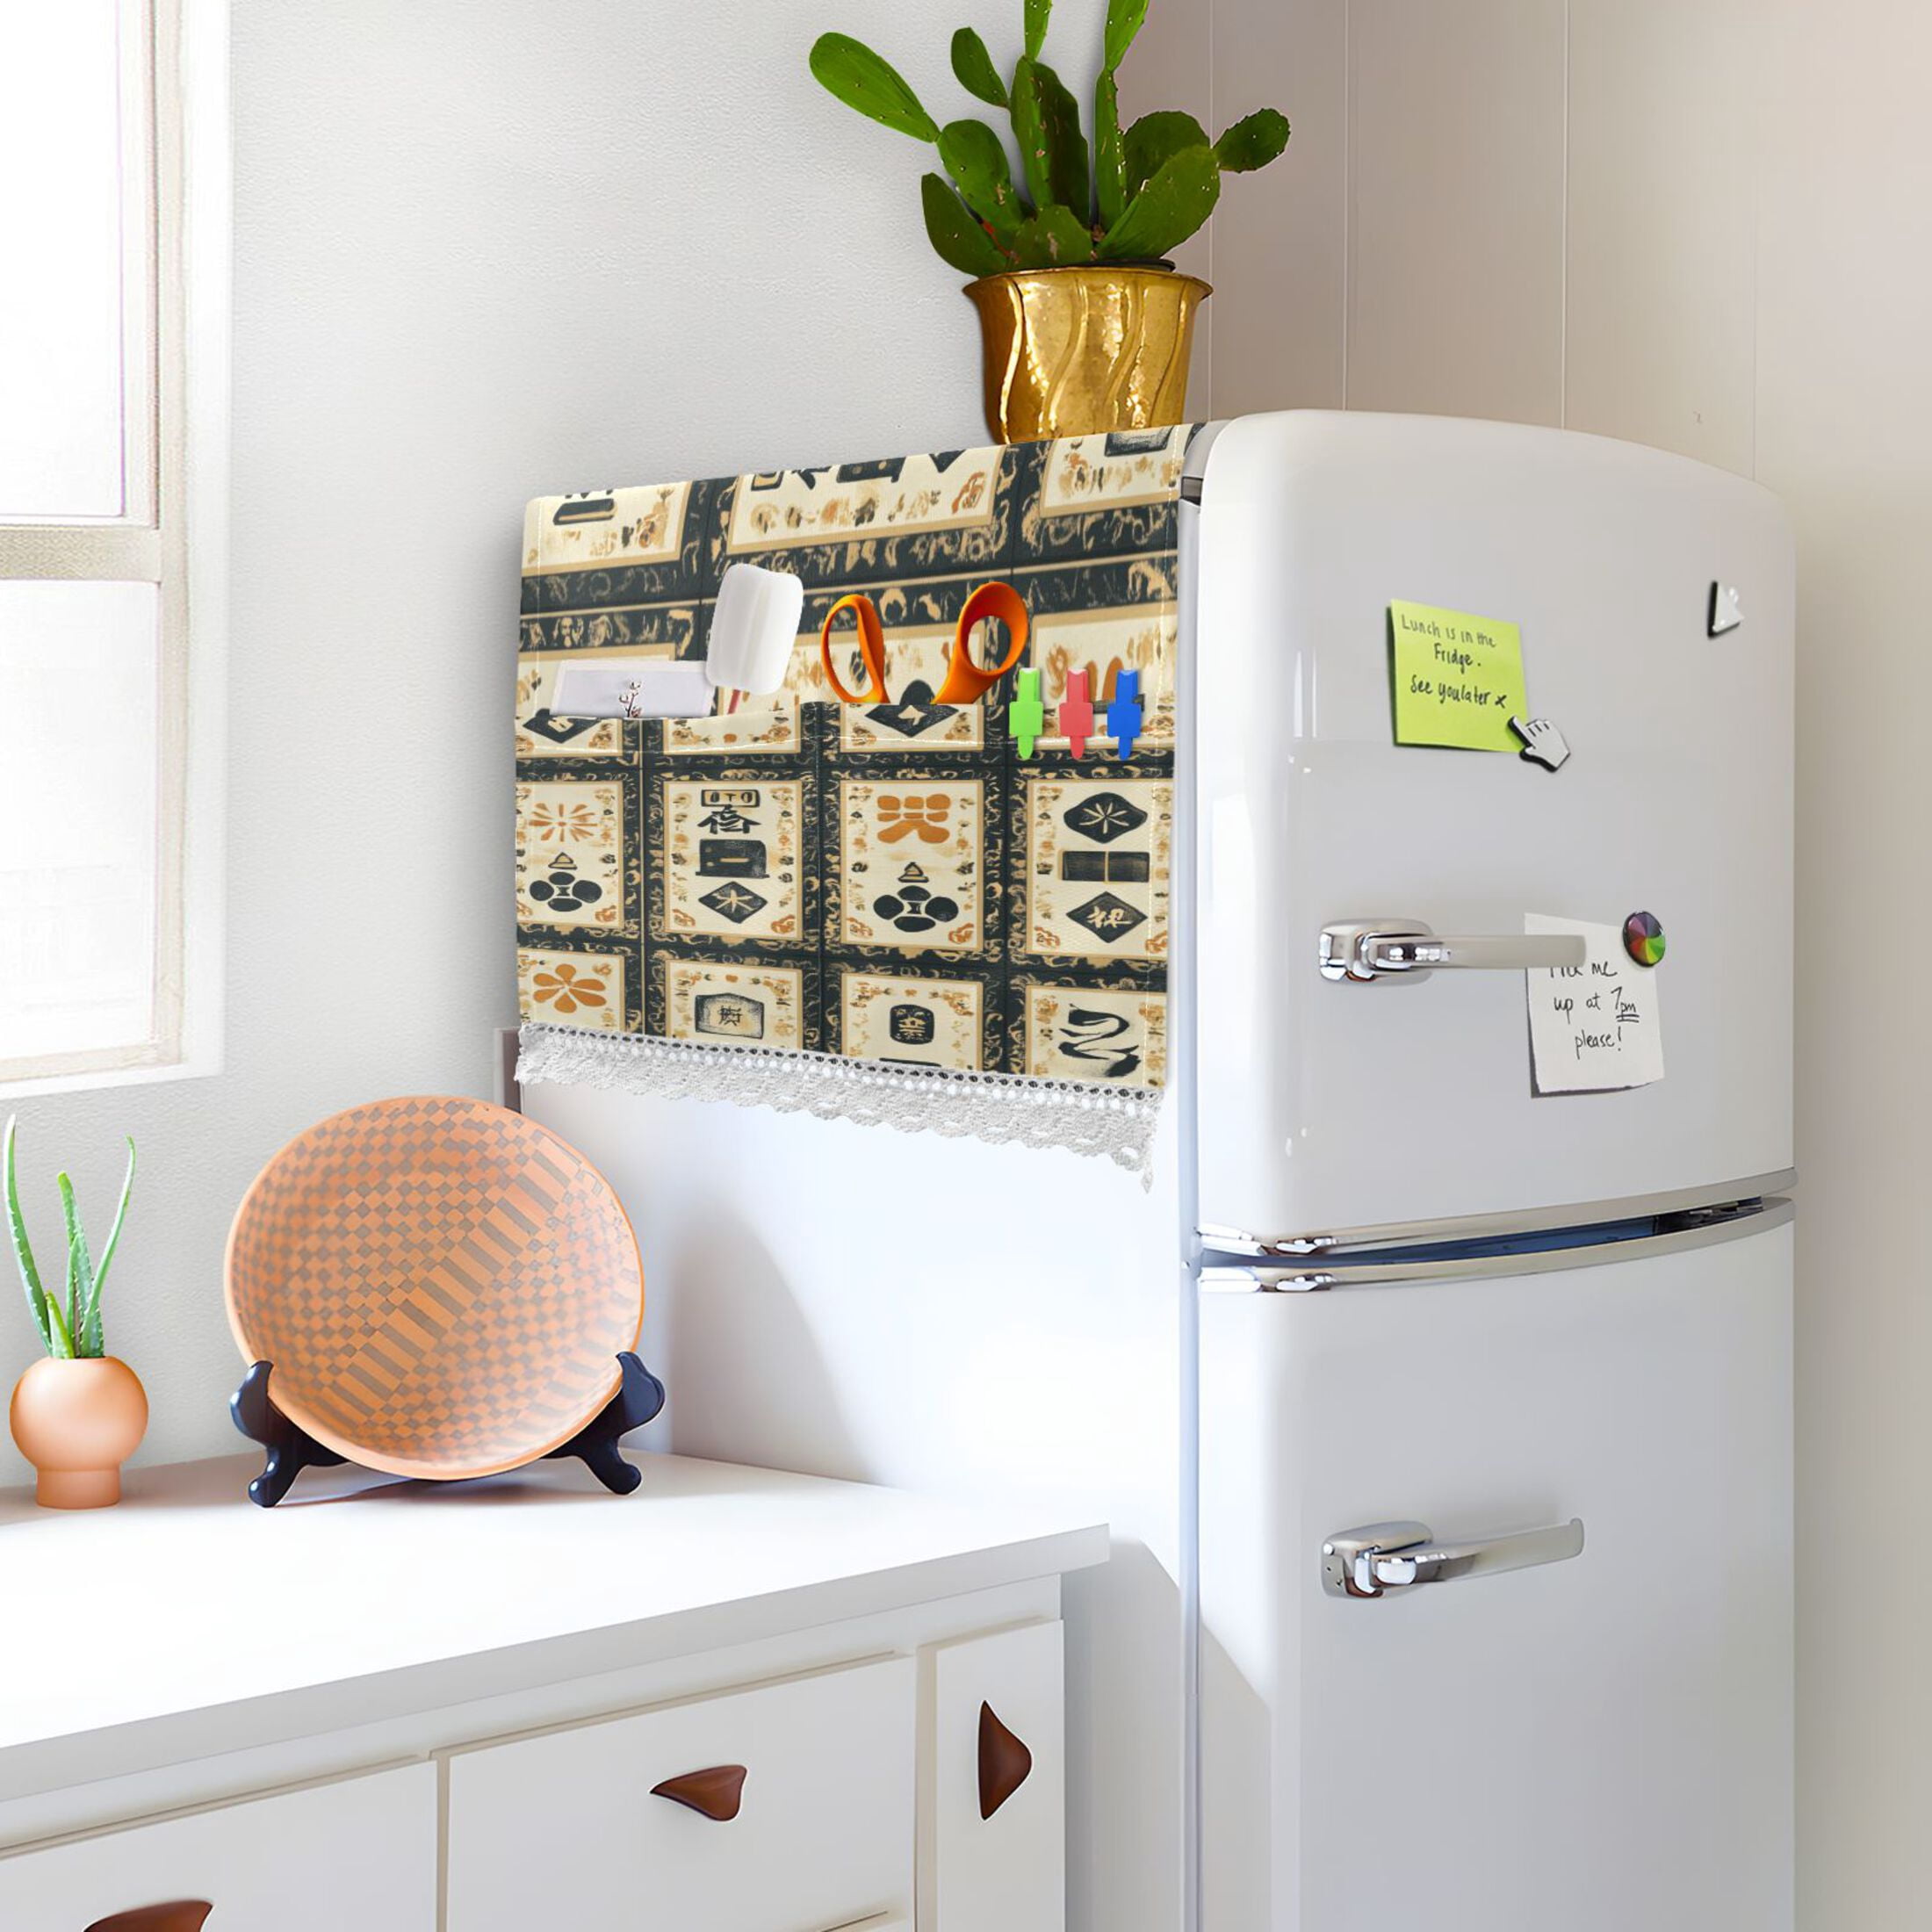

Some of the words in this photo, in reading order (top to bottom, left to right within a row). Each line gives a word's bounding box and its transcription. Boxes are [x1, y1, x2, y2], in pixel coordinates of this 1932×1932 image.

[1402, 614, 1441, 638] Lunch
[1445, 627, 1456, 640] is
[1460, 631, 1474, 644] in
[1476, 631, 1496, 648] the
[1410, 674, 1433, 694] See
[1591, 961, 1618, 977] me
[1554, 997, 1574, 1025] up
[1586, 992, 1601, 1010] at
[1575, 1026, 1622, 1060] please!
